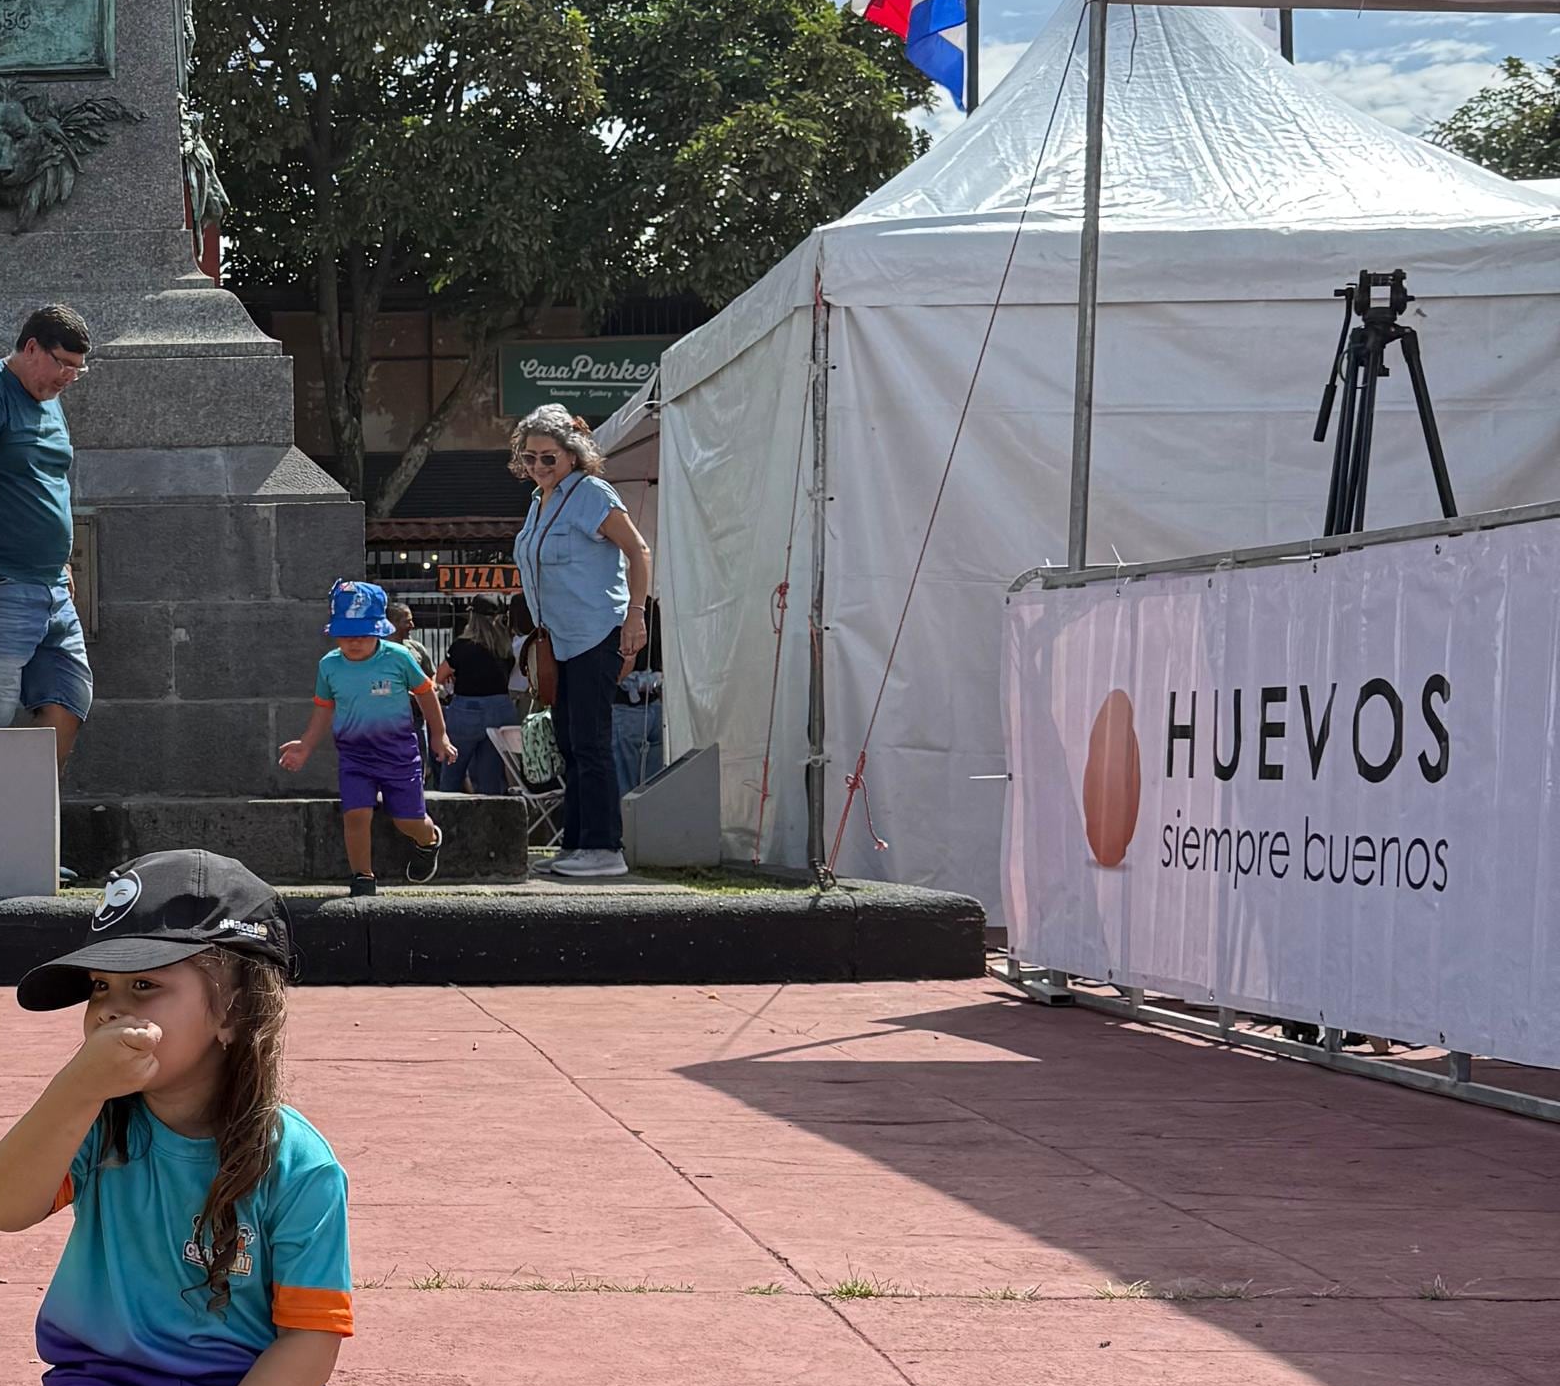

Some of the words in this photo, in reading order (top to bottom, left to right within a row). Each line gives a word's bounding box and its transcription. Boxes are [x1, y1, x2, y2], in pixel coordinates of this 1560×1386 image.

[520, 358, 571, 379] Casa
[440, 567, 505, 588] PIZZA
[1166, 673, 1451, 784] HUEVOS
[1161, 809, 1291, 890] siempre
[1303, 815, 1450, 892] buenos
